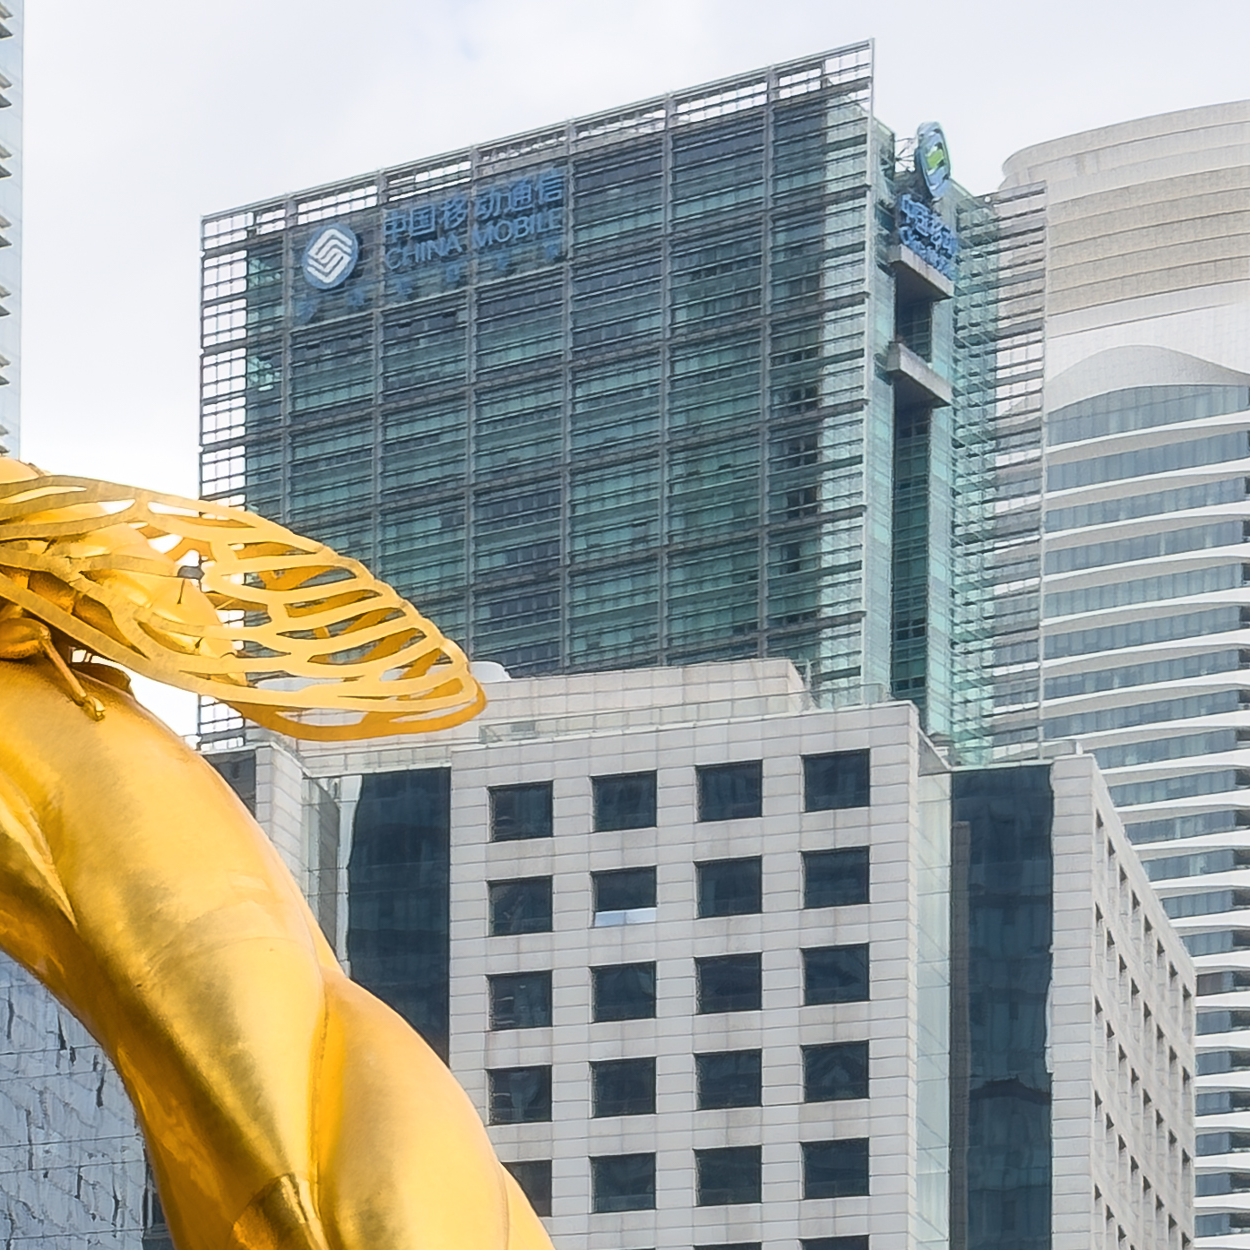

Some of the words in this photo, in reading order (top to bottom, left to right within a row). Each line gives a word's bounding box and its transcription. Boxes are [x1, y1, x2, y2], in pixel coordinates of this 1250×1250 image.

[383, 168, 563, 243] 中国移动通信
[385, 232, 463, 270] CHINA
[471, 206, 563, 250] MOBILE
